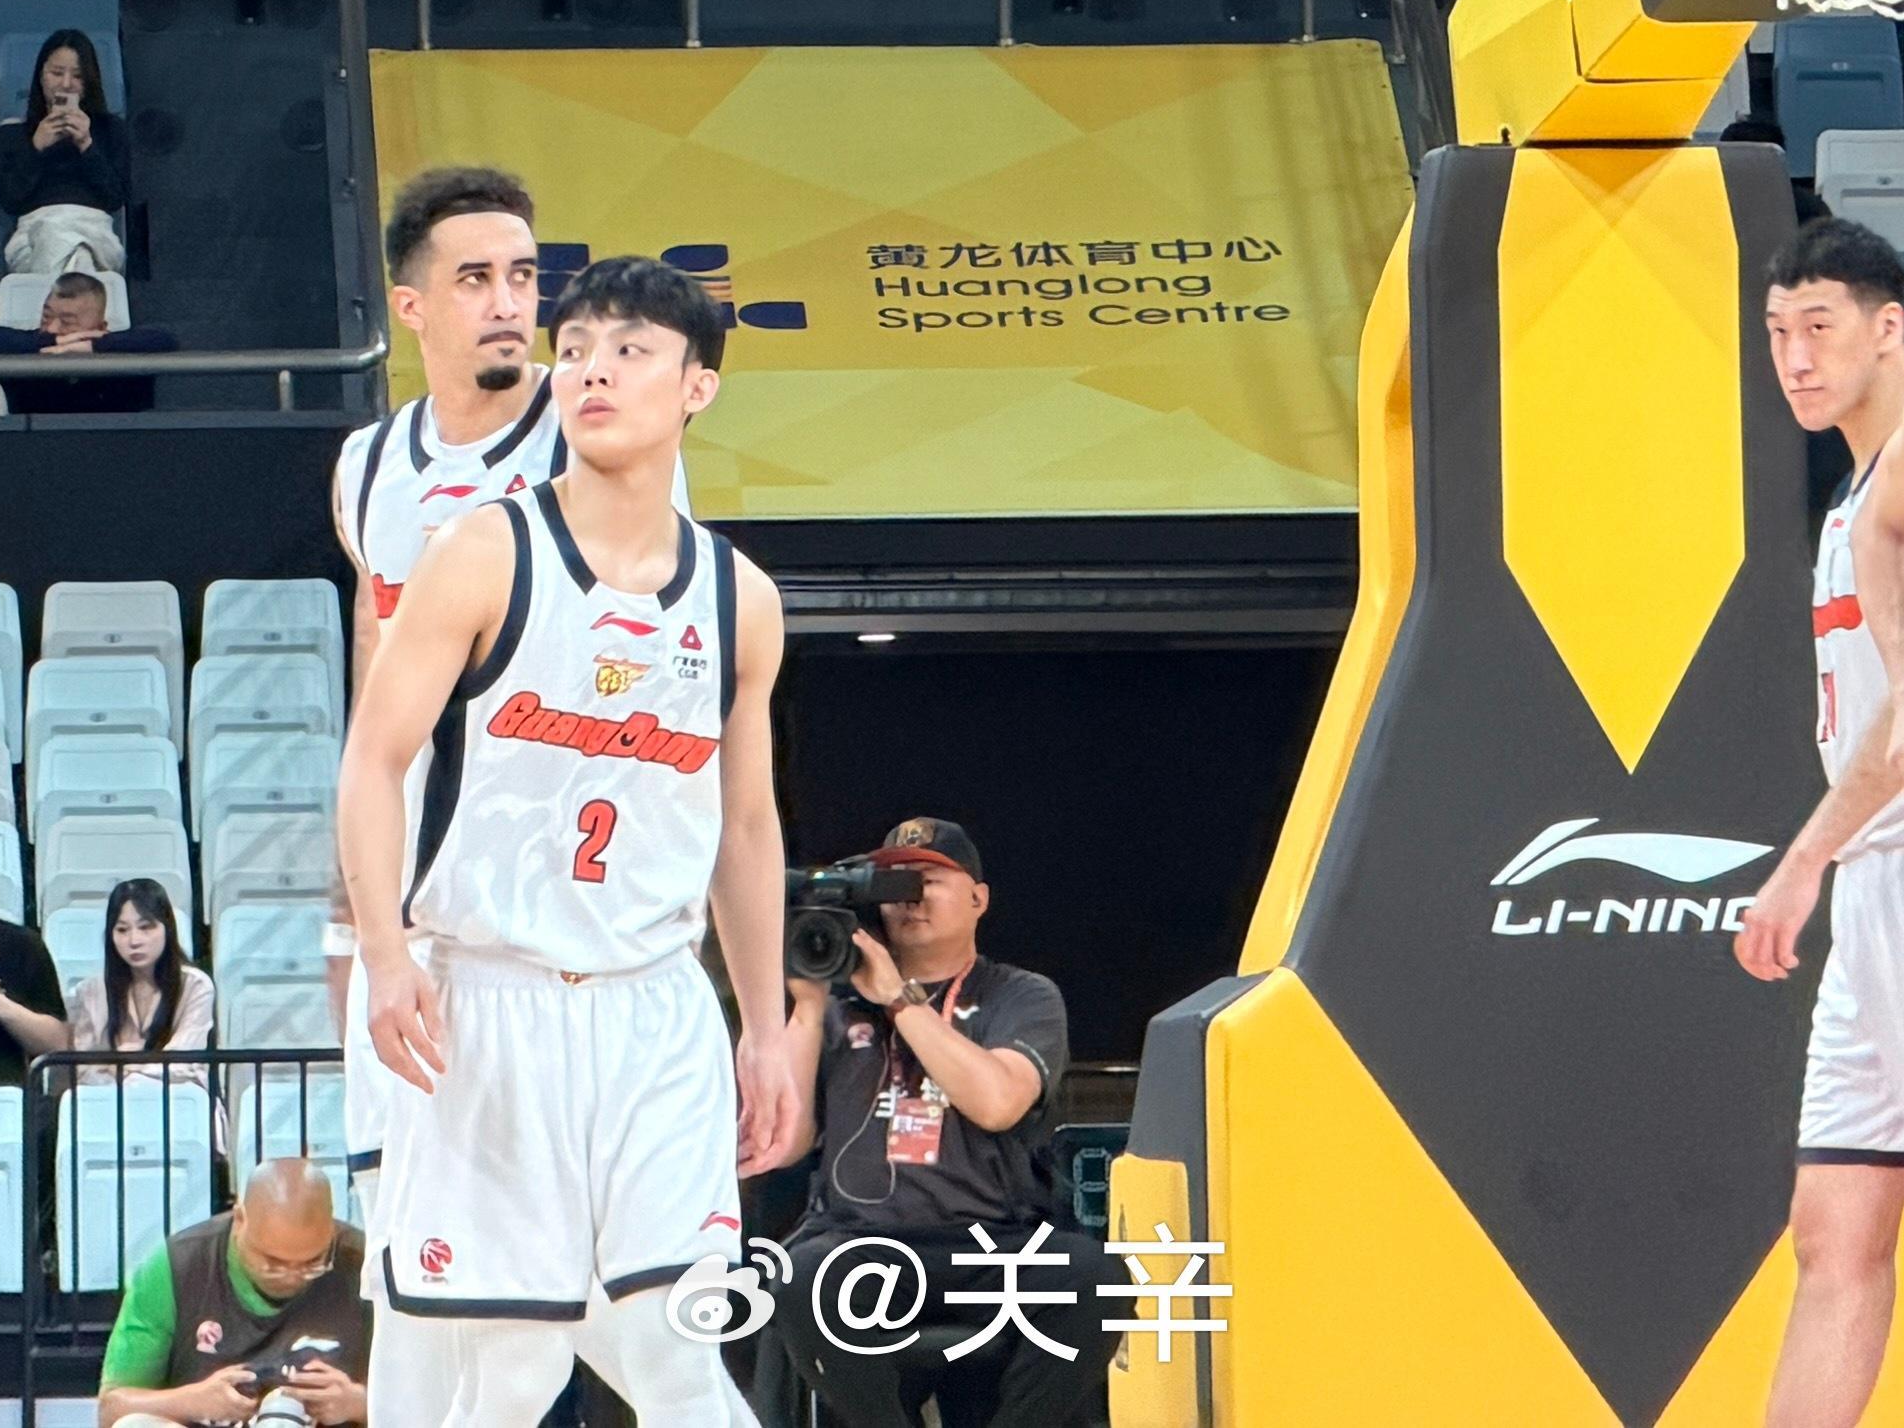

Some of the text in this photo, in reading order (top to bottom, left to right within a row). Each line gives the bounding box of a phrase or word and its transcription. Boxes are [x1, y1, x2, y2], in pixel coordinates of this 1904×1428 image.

[866, 236, 1283, 271] 黄龙体育中心
[874, 272, 1211, 301] Huanglong
[878, 298, 1290, 333] Sports Centre
[572, 798, 617, 884] 2
